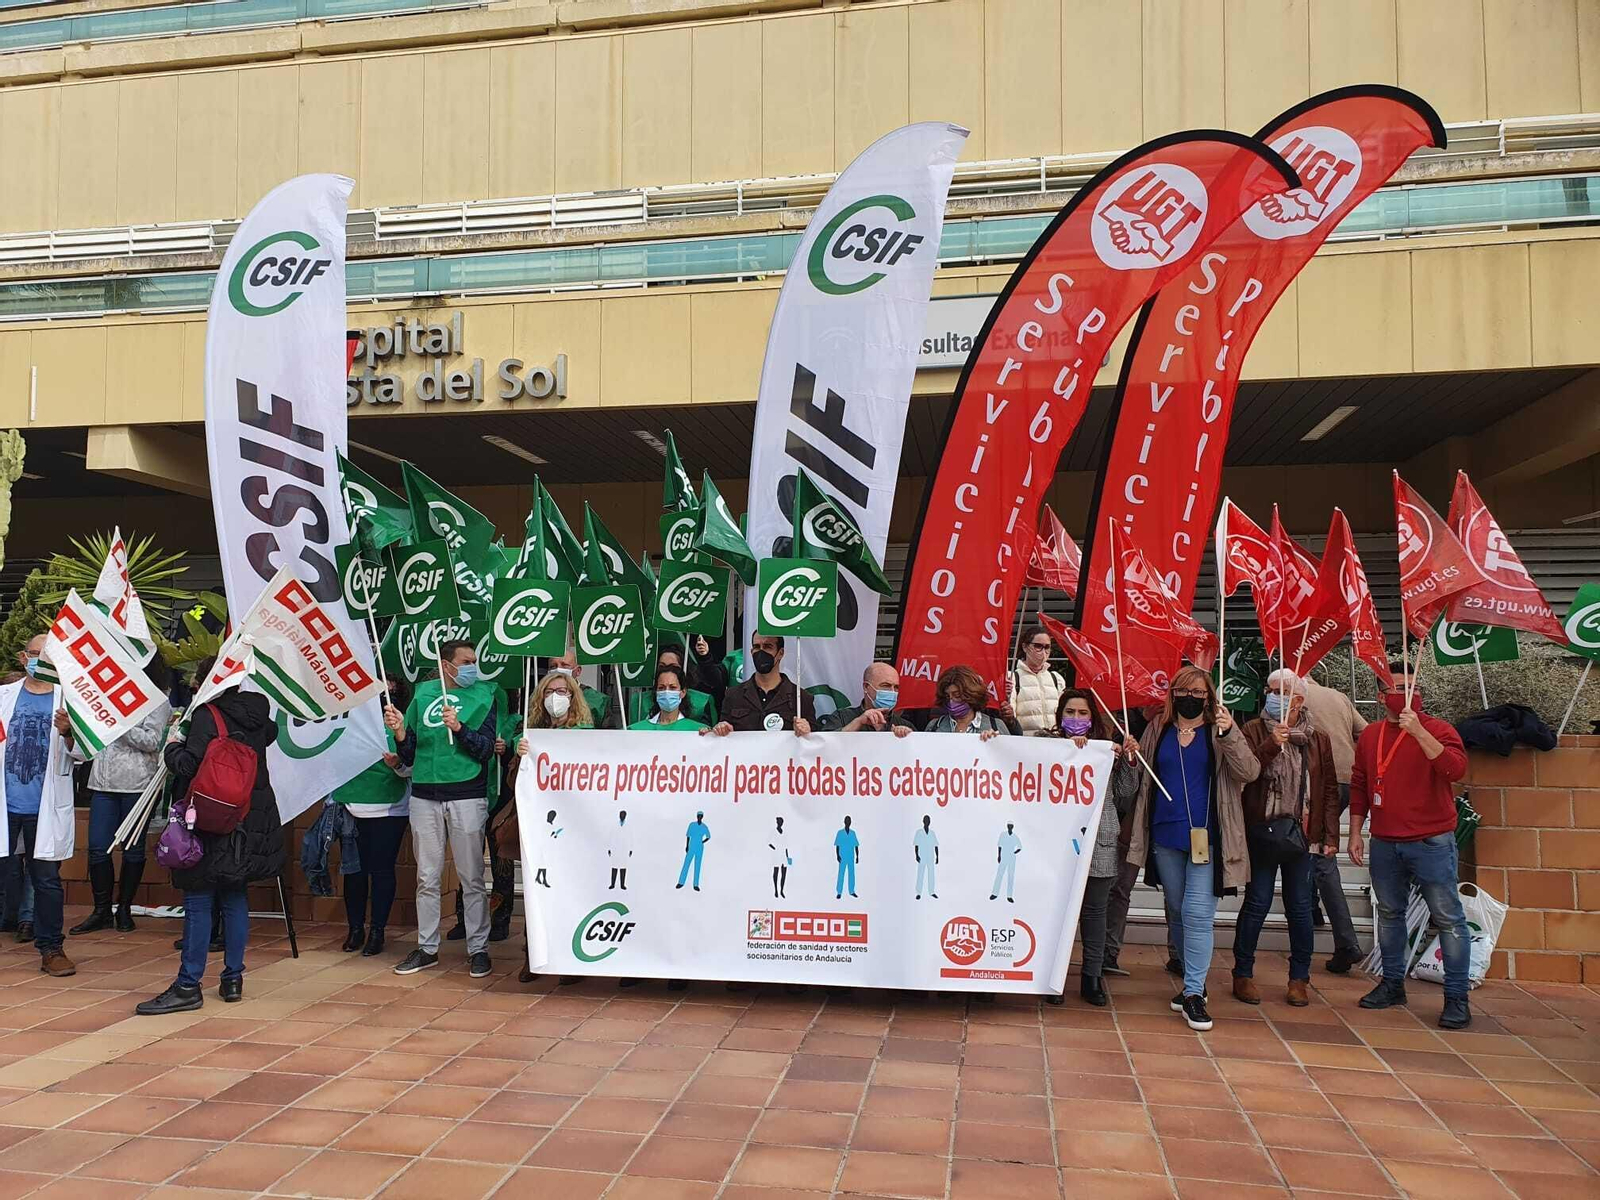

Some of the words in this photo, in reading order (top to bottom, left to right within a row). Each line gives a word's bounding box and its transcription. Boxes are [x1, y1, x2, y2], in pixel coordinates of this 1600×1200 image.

[1125, 171, 1202, 241] UGT
[832, 224, 924, 265] CSIF
[250, 257, 331, 287] CSIF
[347, 369, 404, 406] sta
[415, 358, 484, 401] del
[500, 354, 567, 399] Sol
[924, 273, 1074, 634] Servicios
[236, 378, 342, 602] CSIF
[672, 532, 694, 551] CSI
[814, 514, 863, 546] CSIF
[352, 567, 387, 591] CSIF
[404, 569, 445, 595] CSIF
[672, 584, 719, 609] CSIF
[776, 585, 828, 607] CSIF
[507, 605, 560, 628] CSIF
[589, 613, 635, 636] CSIF
[274, 579, 374, 693] CCOO
[52, 604, 149, 718] CCOO
[300, 644, 346, 702] Málaga
[70, 675, 118, 728] Málaga
[1223, 684, 1252, 697] CSIF
[536, 752, 610, 792] Carrera
[614, 755, 729, 800] profesional
[734, 763, 781, 803] para
[787, 757, 846, 796] todas
[852, 757, 882, 796] las
[889, 758, 1002, 807] categorías
[1009, 762, 1042, 802] del
[1048, 763, 1095, 806] SAS
[585, 920, 636, 942] CSIF
[780, 917, 845, 936] CCOO
[947, 923, 979, 940] UGT
[747, 941, 785, 951] federación
[798, 943, 828, 952] sanidad
[836, 945, 868, 953] sectores
[747, 952, 803, 961] sociosanitarios
[804, 953, 814, 961] de
